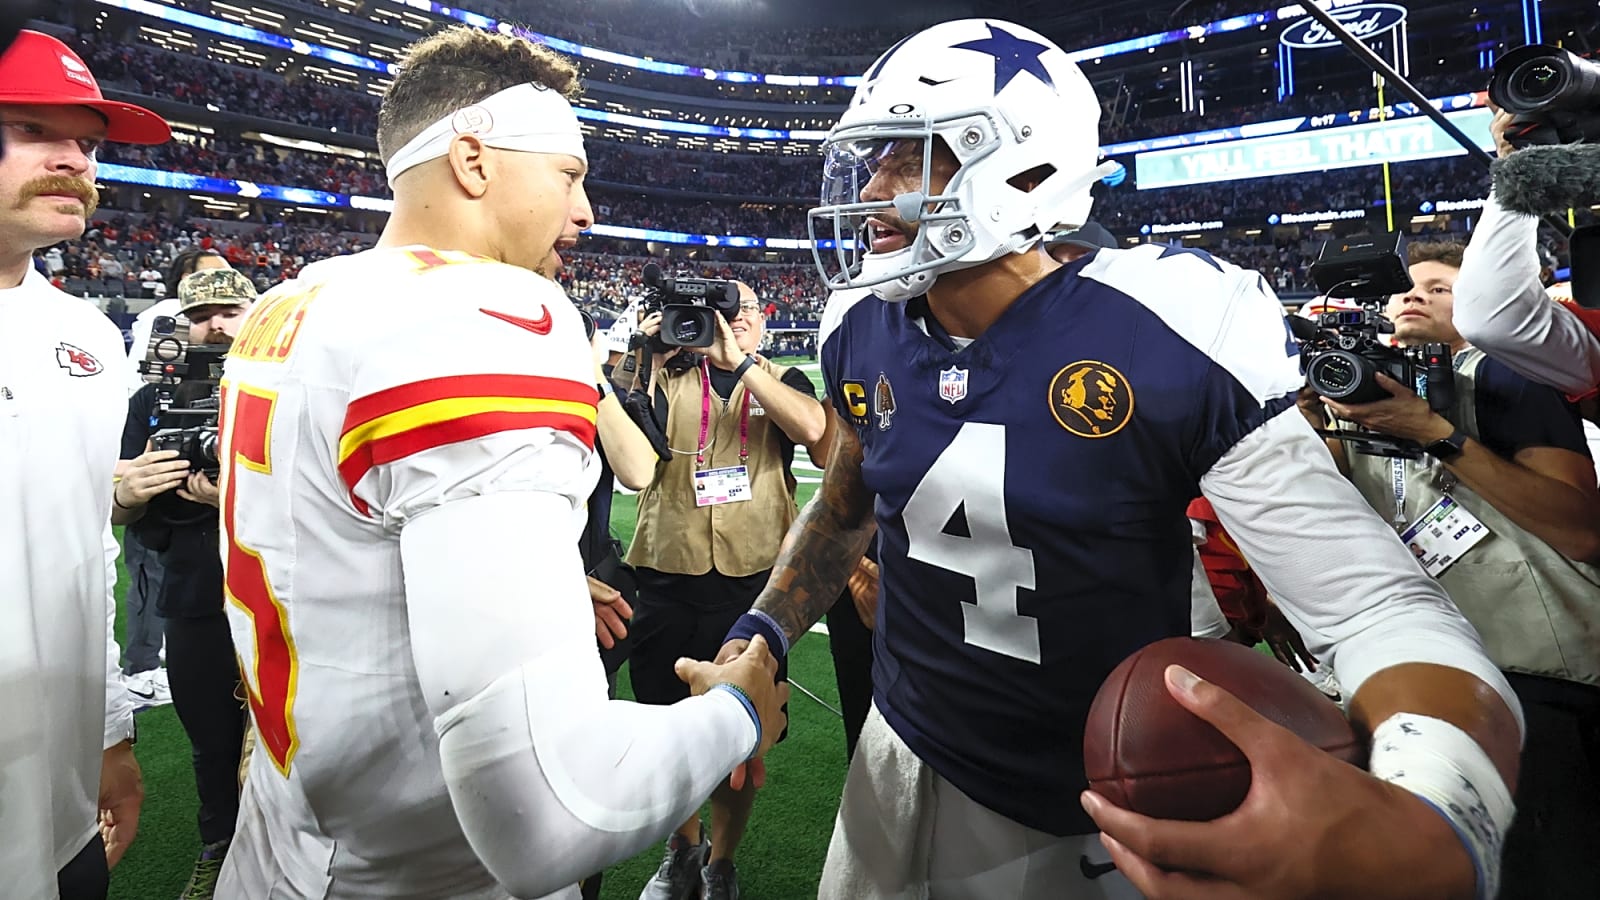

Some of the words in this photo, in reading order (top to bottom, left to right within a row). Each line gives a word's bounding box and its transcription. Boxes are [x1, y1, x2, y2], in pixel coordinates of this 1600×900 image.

[1255, 140, 1320, 170] FEEL
[843, 382, 868, 417] C
[943, 383, 963, 397] NFL
[749, 407, 766, 417] MED
[902, 421, 1041, 665] 4
